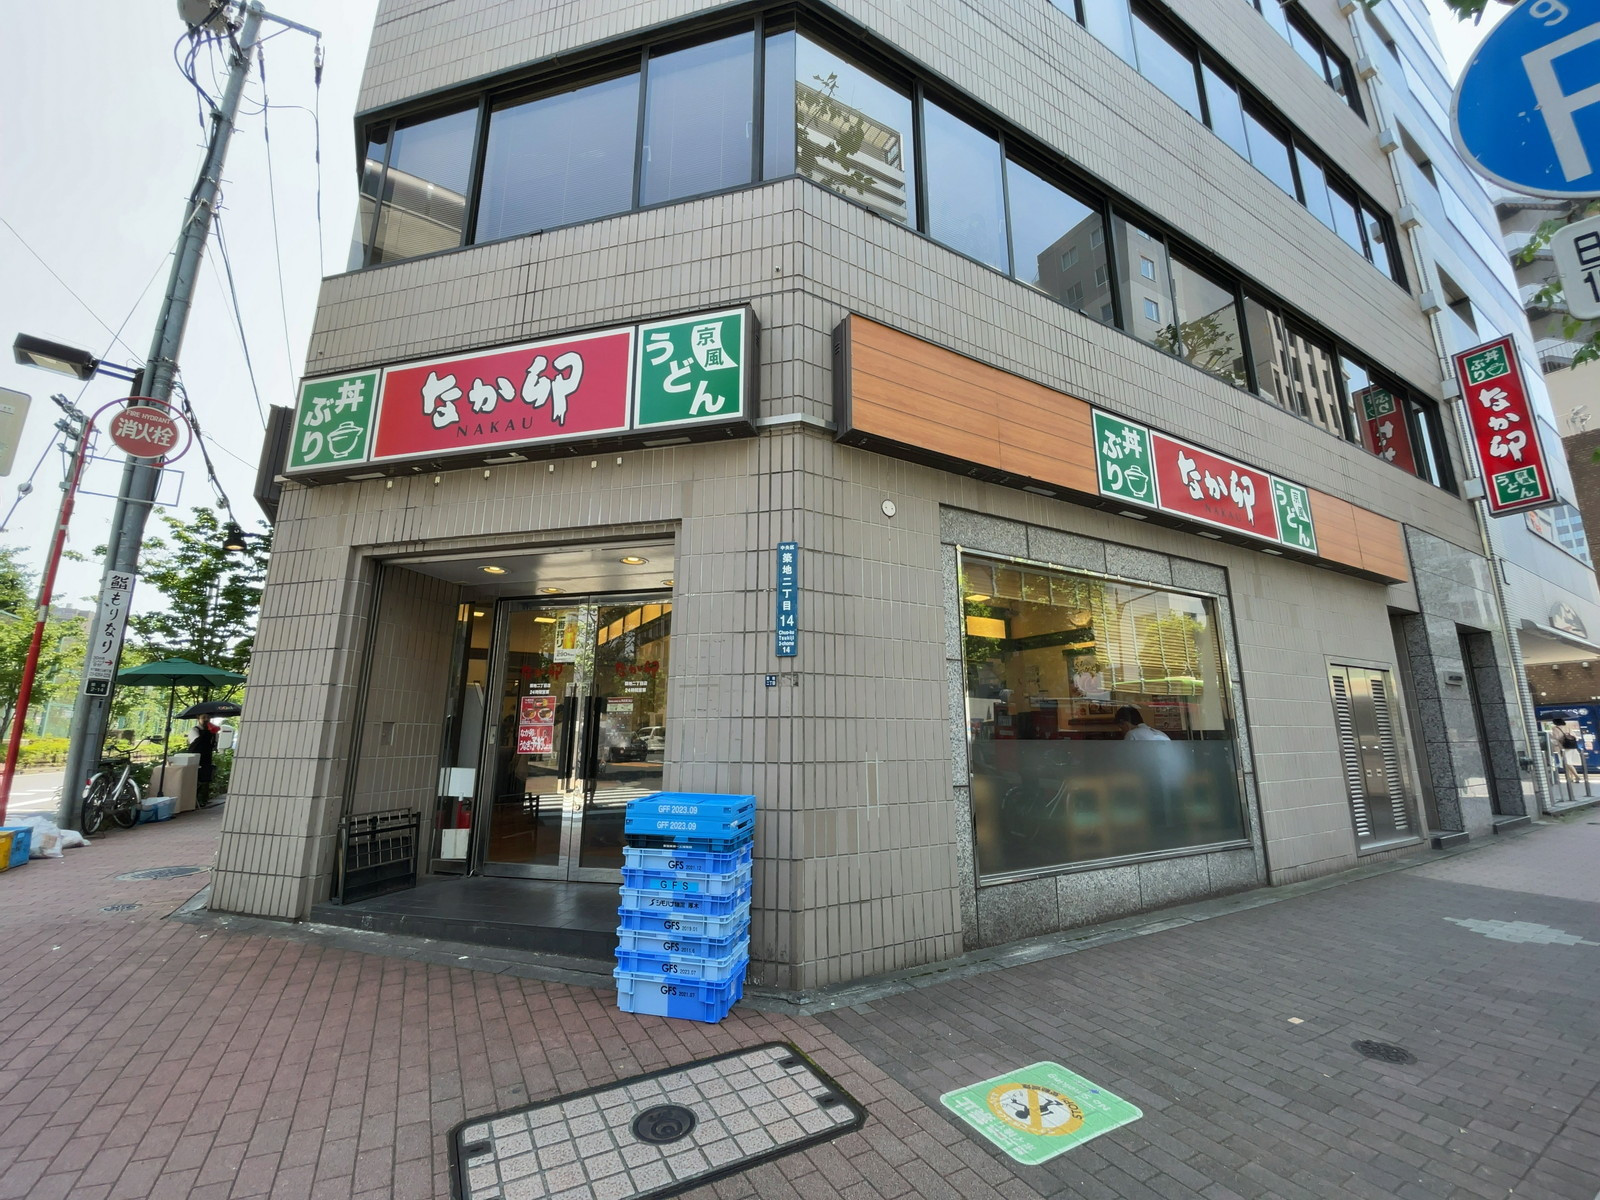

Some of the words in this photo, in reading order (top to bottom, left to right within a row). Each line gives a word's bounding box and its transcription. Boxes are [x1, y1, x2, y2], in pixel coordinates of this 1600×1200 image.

[696, 327, 724, 367] 京風
[646, 332, 725, 415] うどん
[421, 351, 584, 430] なか卯
[126, 409, 140, 418] FIRE
[141, 413, 172, 425] HYDRANT
[457, 416, 533, 438] NAKAU
[1478, 386, 1527, 463] なか卯
[115, 417, 174, 447] 消火栓
[1177, 450, 1255, 526] なか卯
[1496, 475, 1534, 499] うどん
[1276, 483, 1311, 547] うどん
[782, 552, 793, 611] 築地二丁目
[780, 614, 794, 627] 14
[615, 660, 660, 679] なか卯
[658, 805, 671, 813] GFF
[671, 805, 698, 815] 2023.09
[656, 821, 670, 829] GFF
[670, 821, 697, 831] 2023.09
[668, 860, 684, 870] GFS
[663, 920, 680, 931] GFS
[663, 941, 680, 952] GFS
[661, 963, 678, 974] GFS
[660, 985, 677, 996] GFS
